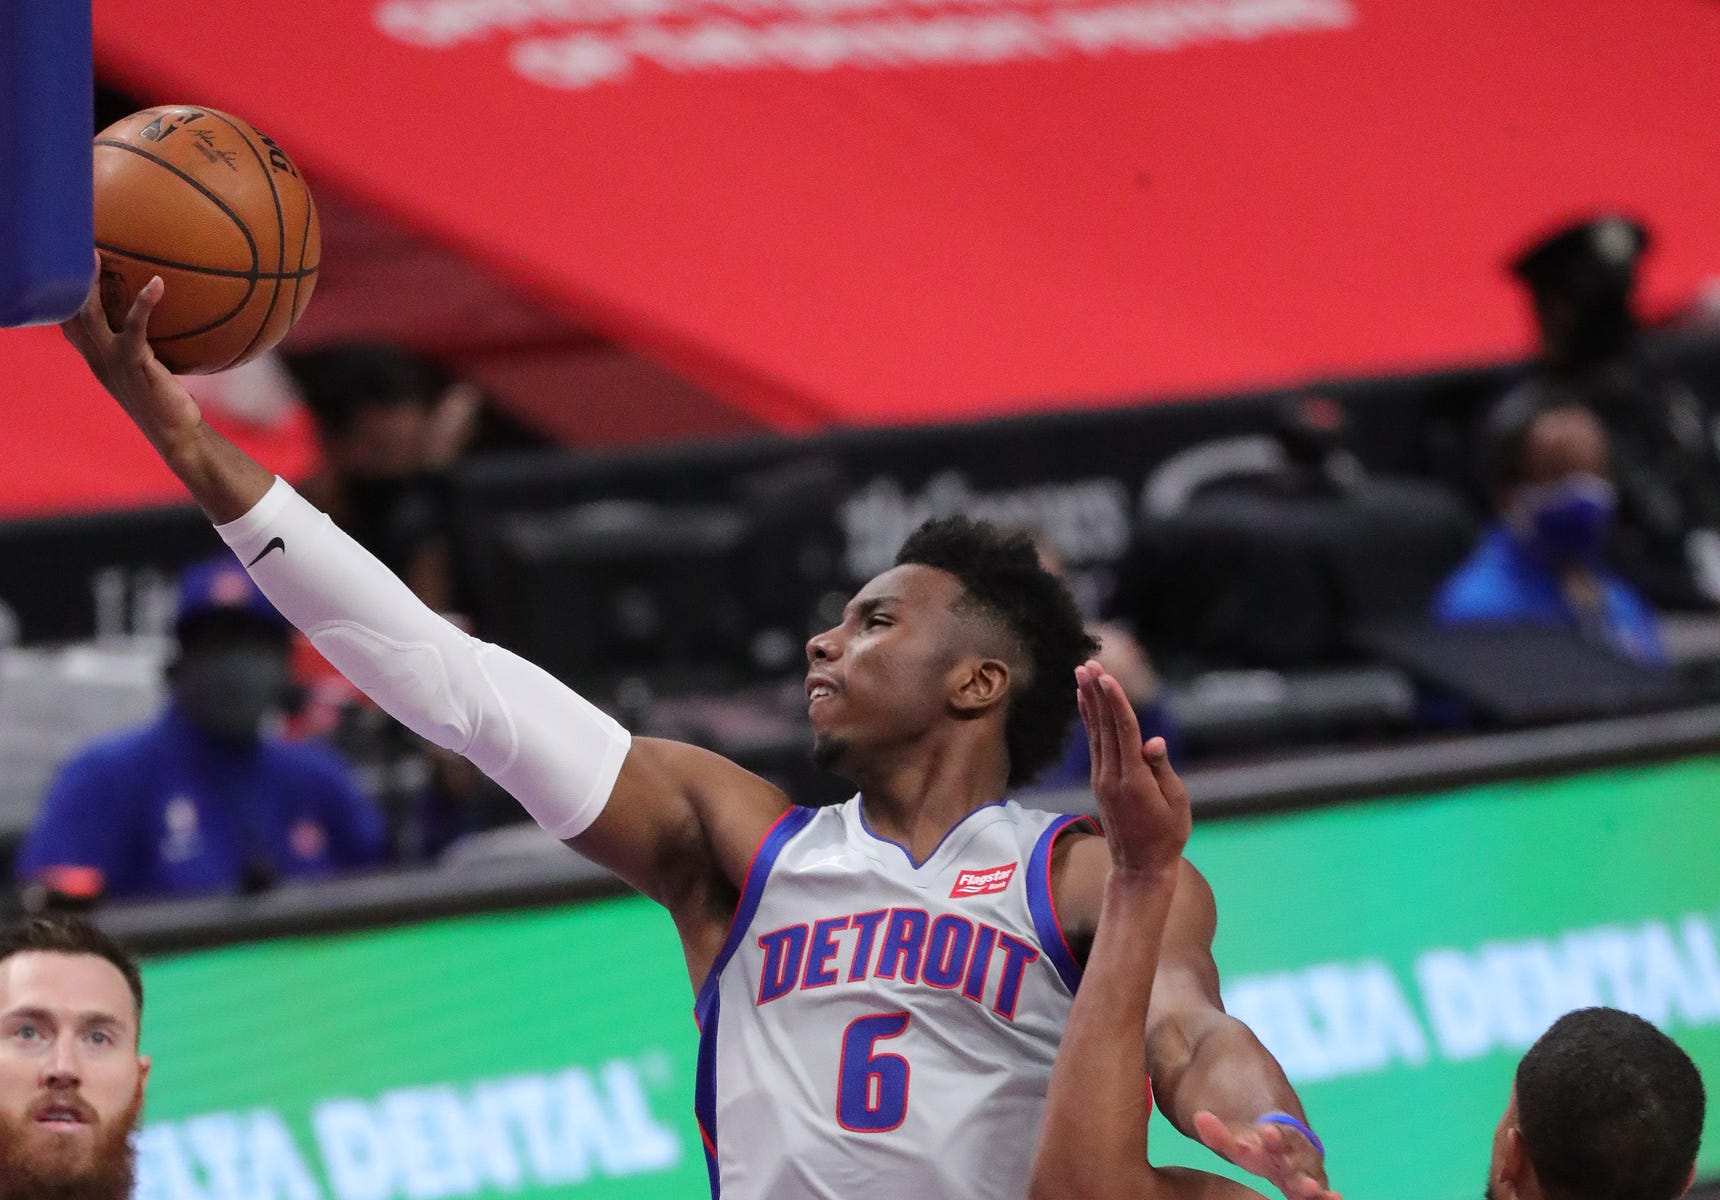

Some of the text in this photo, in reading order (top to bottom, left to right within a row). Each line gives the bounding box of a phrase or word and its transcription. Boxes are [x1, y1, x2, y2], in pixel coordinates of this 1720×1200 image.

[959, 869, 1013, 886] Flagstar
[757, 907, 1039, 1021] DETROIT
[836, 1011, 911, 1134] 6
